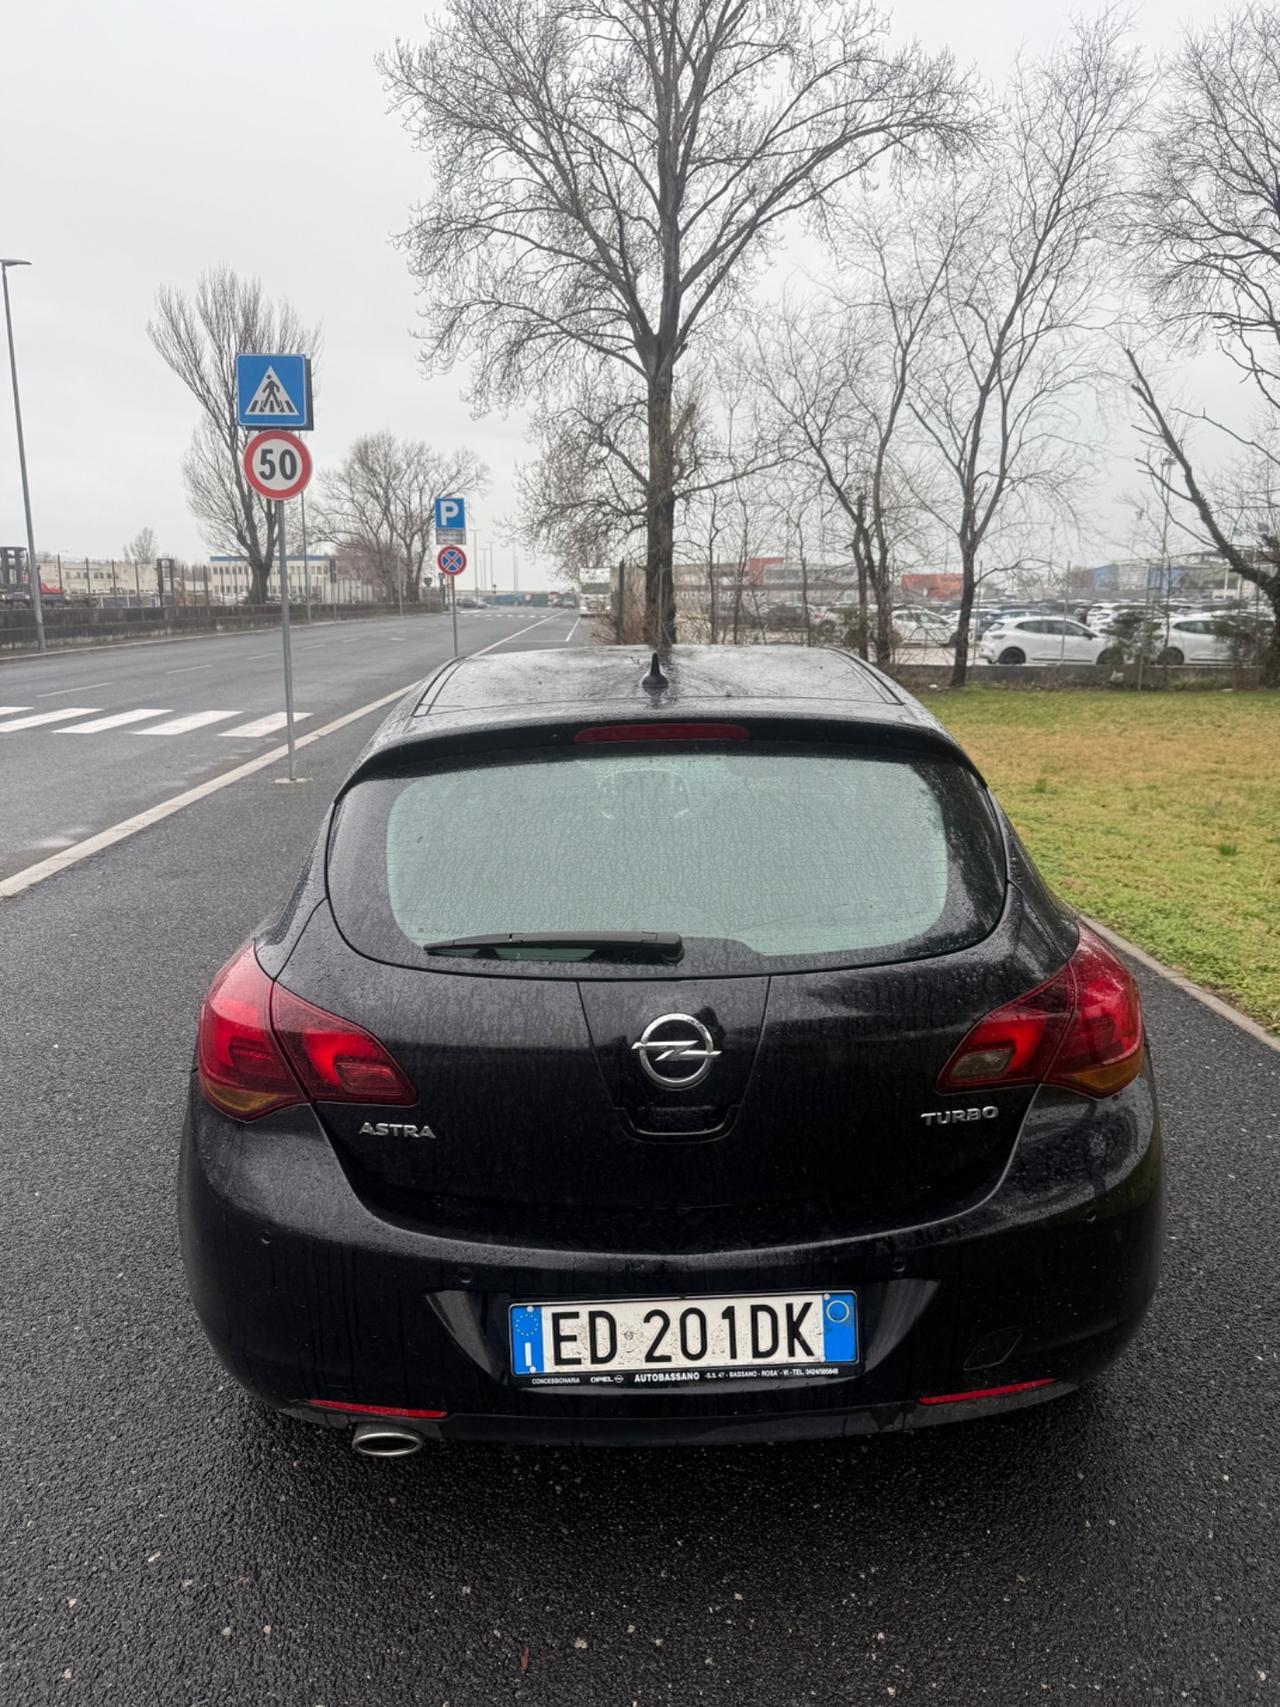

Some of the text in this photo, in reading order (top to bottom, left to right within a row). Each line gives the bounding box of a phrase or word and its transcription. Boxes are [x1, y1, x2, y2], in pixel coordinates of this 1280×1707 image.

[259, 448, 298, 481] 50
[441, 501, 459, 526] P
[920, 1105, 999, 1126] TURBO
[358, 1122, 436, 1139] ASTRA
[590, 1376, 614, 1384] OPEL
[634, 1371, 700, 1383] AUTOBASSANO
